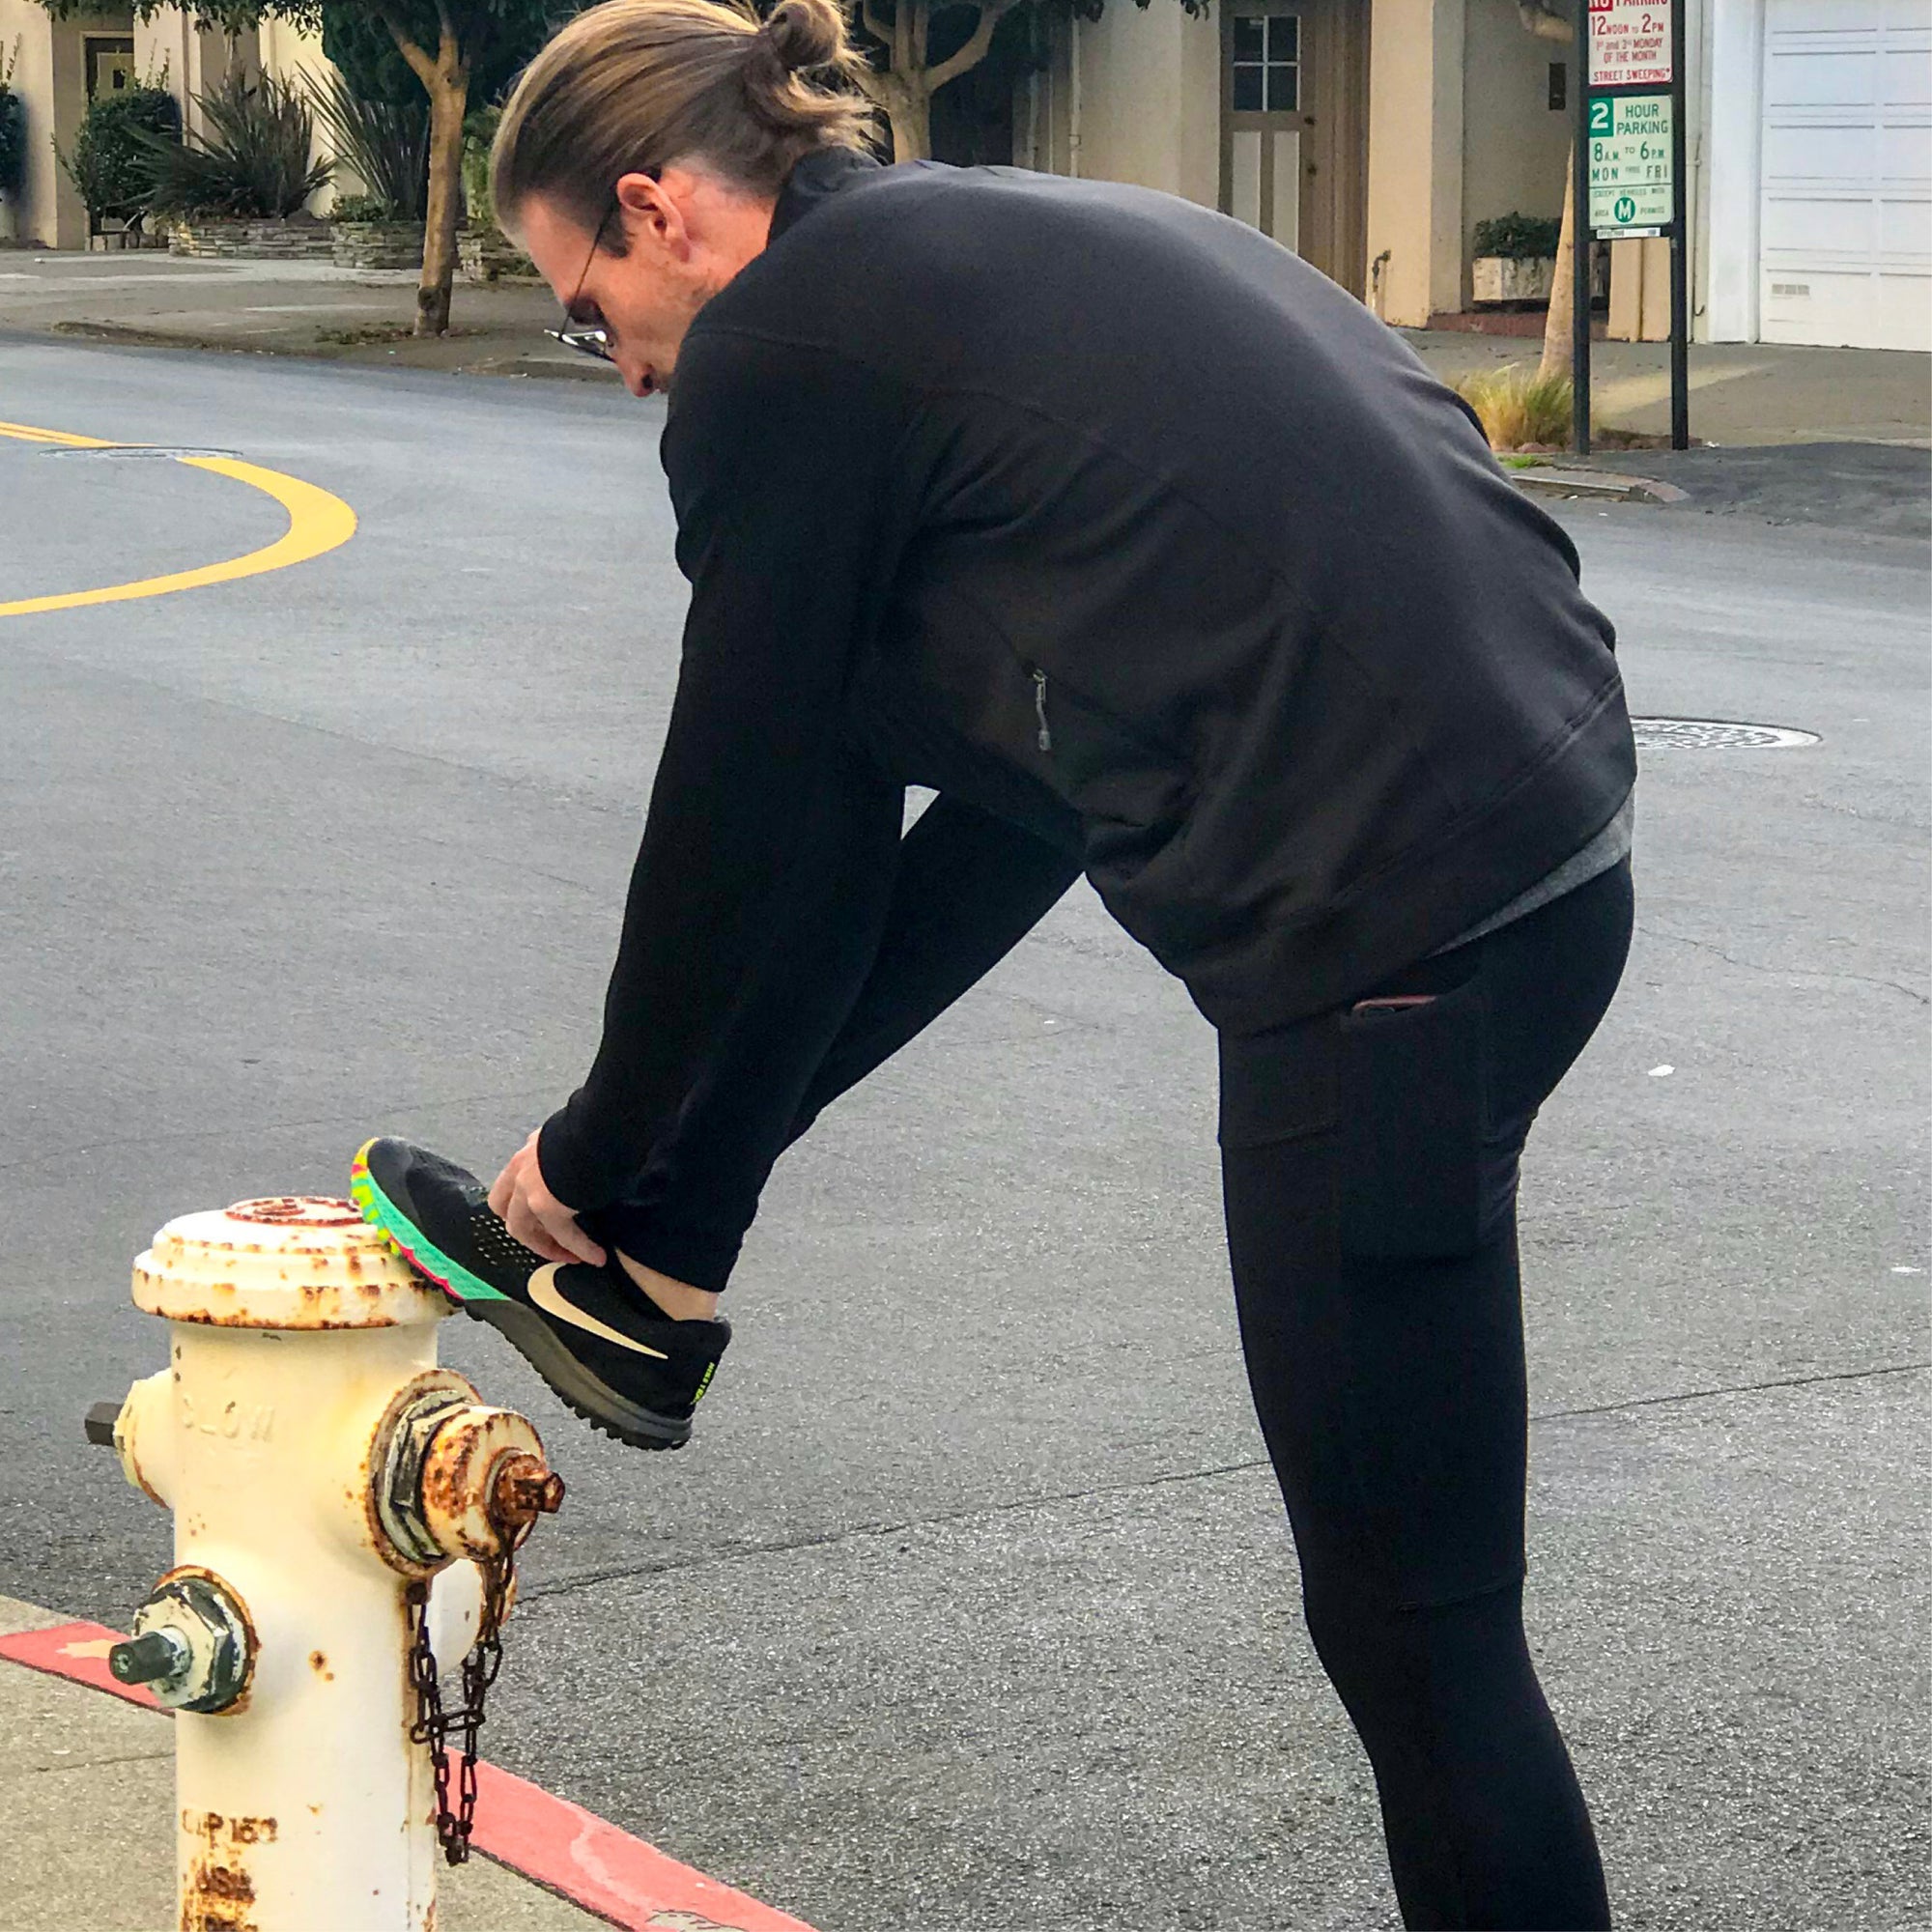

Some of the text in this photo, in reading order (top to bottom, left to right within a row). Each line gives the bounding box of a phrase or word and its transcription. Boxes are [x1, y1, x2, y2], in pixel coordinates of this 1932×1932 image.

[1634, 39, 1662, 48] MONDAY
[1604, 50, 1657, 64] OF THE MONTH
[1594, 71, 1623, 81] STREET
[1591, 101, 1660, 129] 2 HOUR
[1616, 120, 1668, 135] PARKING
[1592, 167, 1619, 182] MON
[1646, 164, 1668, 179] FRI
[1618, 200, 1633, 219] M
